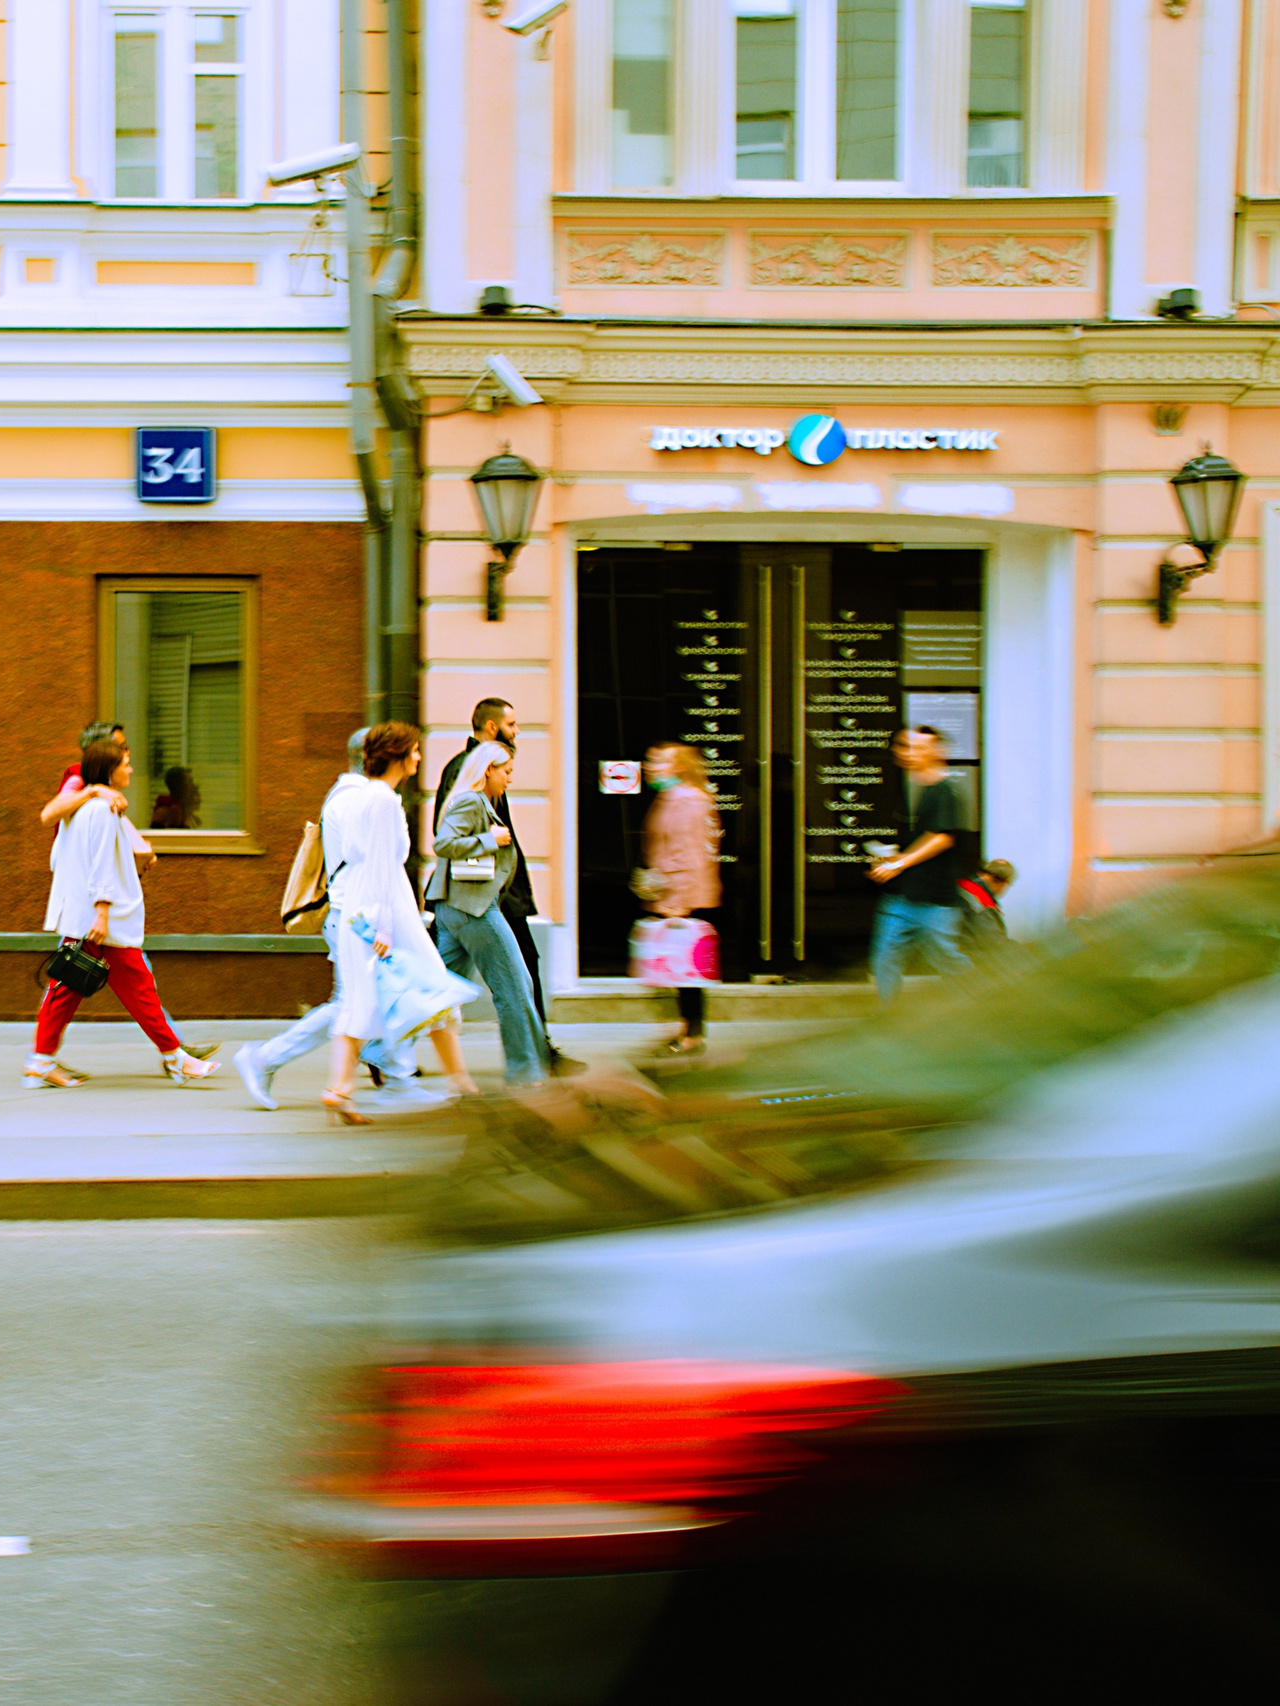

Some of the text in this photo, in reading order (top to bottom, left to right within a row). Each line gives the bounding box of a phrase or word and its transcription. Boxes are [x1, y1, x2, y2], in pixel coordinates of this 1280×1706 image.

[141, 446, 206, 484] 34
[676, 621, 750, 629] гинекология
[807, 622, 895, 630] пластическая
[817, 632, 882, 642] хирургия
[677, 645, 747, 656] флебология
[805, 659, 899, 668] инъекционная
[681, 673, 742, 682] снижение
[805, 669, 896, 678] косметология
[809, 694, 889, 704] аппаратная
[684, 707, 741, 717] хирургия
[805, 704, 896, 713] косметология
[679, 733, 745, 742] ортопедия
[817, 765, 882, 775] лазерная
[817, 776, 883, 785] эпиляция
[824, 799, 874, 811] ботокс
[806, 828, 898, 837] озонотерапия
